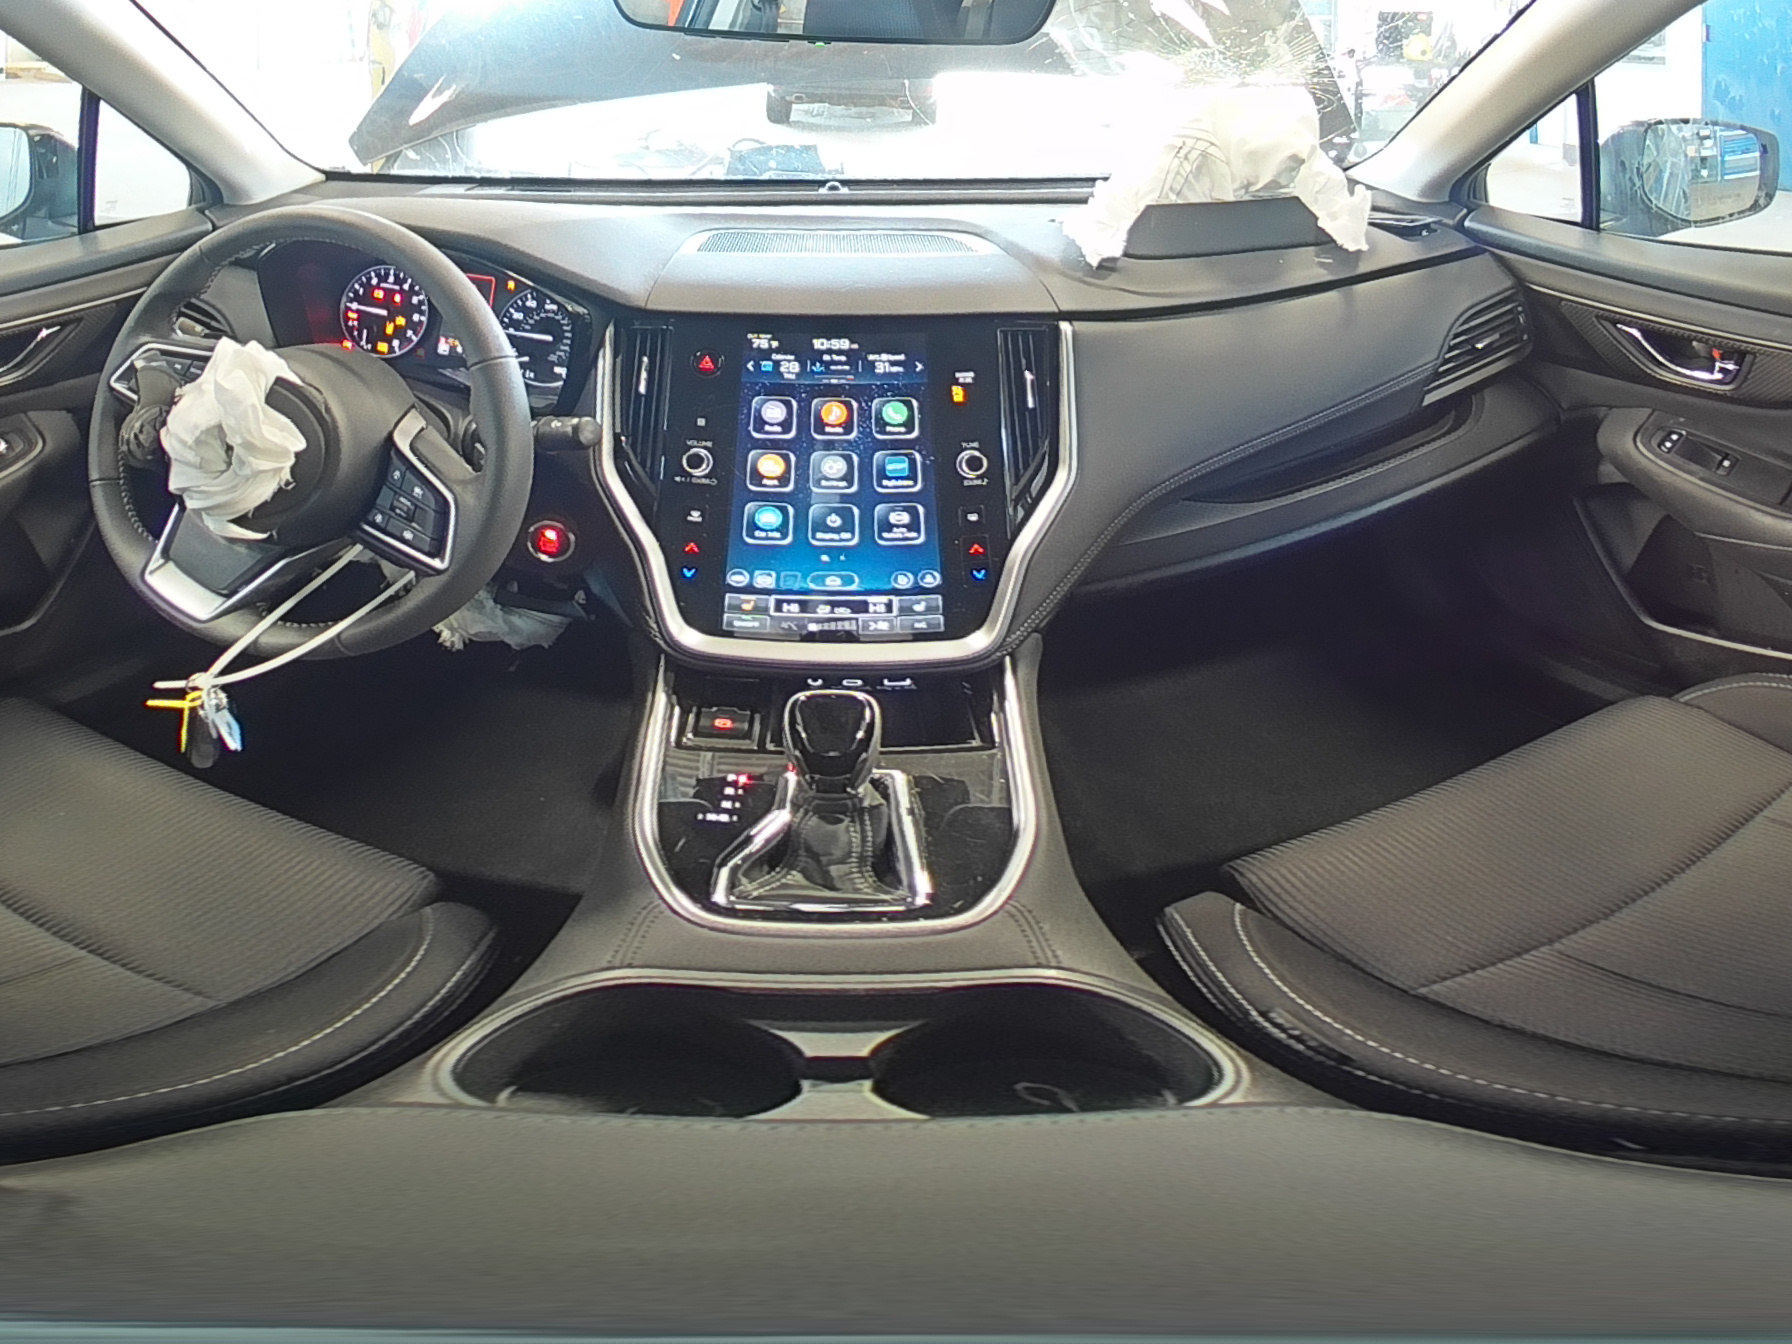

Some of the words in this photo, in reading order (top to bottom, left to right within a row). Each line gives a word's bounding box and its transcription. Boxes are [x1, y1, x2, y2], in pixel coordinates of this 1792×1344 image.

[752, 339, 769, 349] 75
[812, 338, 850, 349] 10:59
[779, 361, 799, 373] 28
[874, 361, 889, 373] 31
